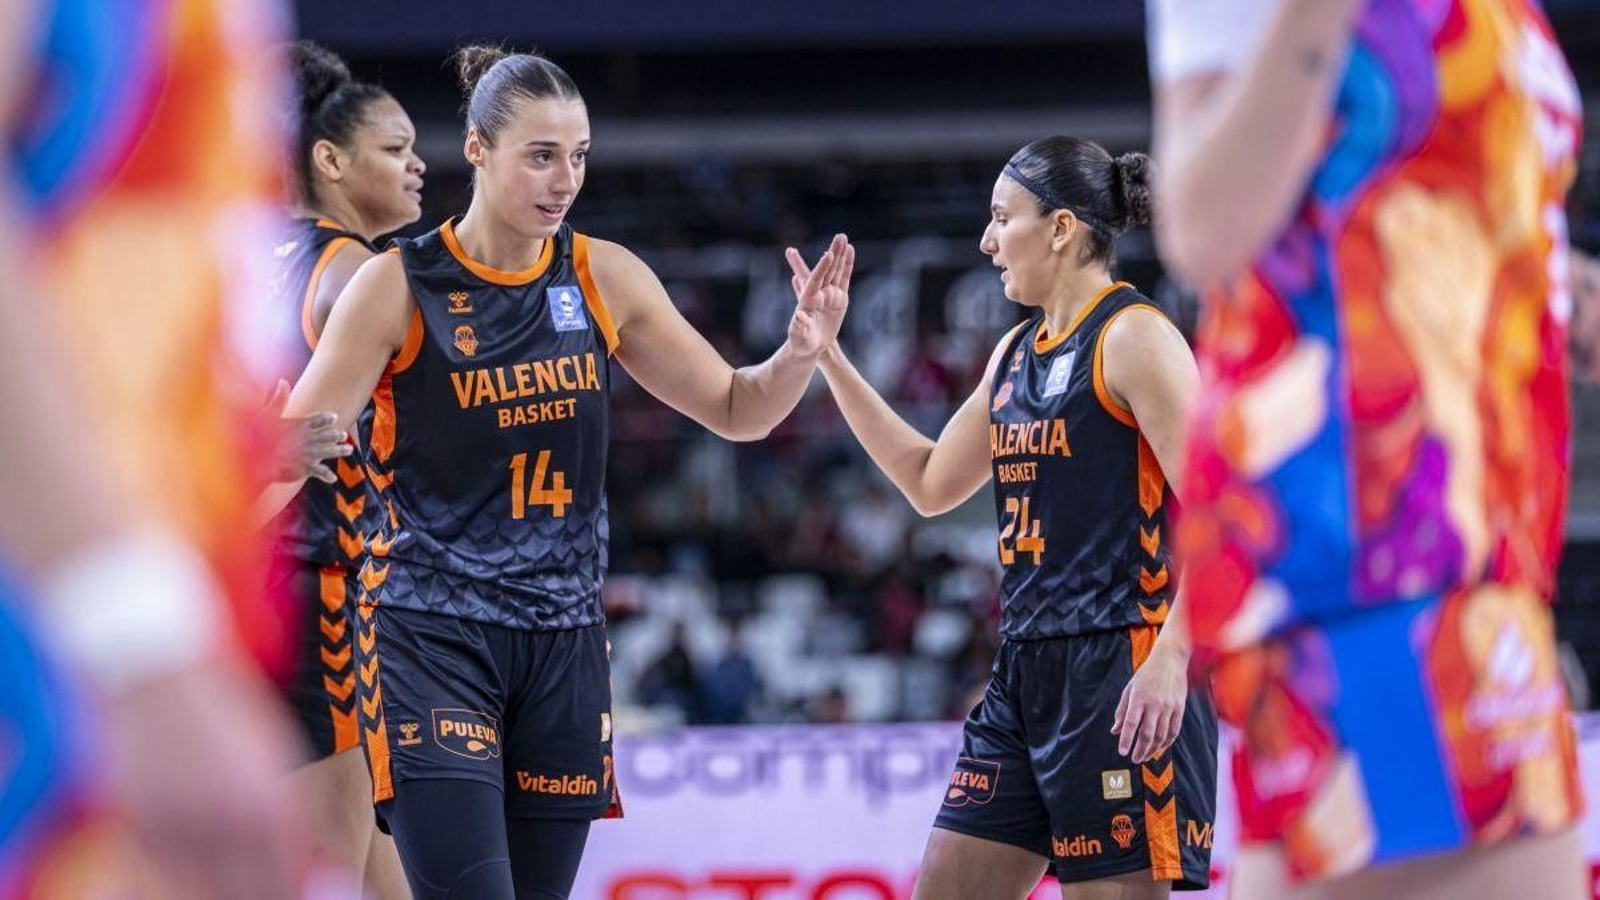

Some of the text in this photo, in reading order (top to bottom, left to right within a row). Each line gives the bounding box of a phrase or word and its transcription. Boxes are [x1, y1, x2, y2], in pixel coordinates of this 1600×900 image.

[451, 353, 601, 410] VALENCIA
[498, 398, 577, 428] BASKET
[990, 418, 1072, 458] ALENCIA
[509, 450, 573, 519] 14
[998, 461, 1039, 483] BASKET
[999, 496, 1046, 566] 24
[440, 719, 497, 744] PULEVA
[516, 771, 598, 796] Vitaldin
